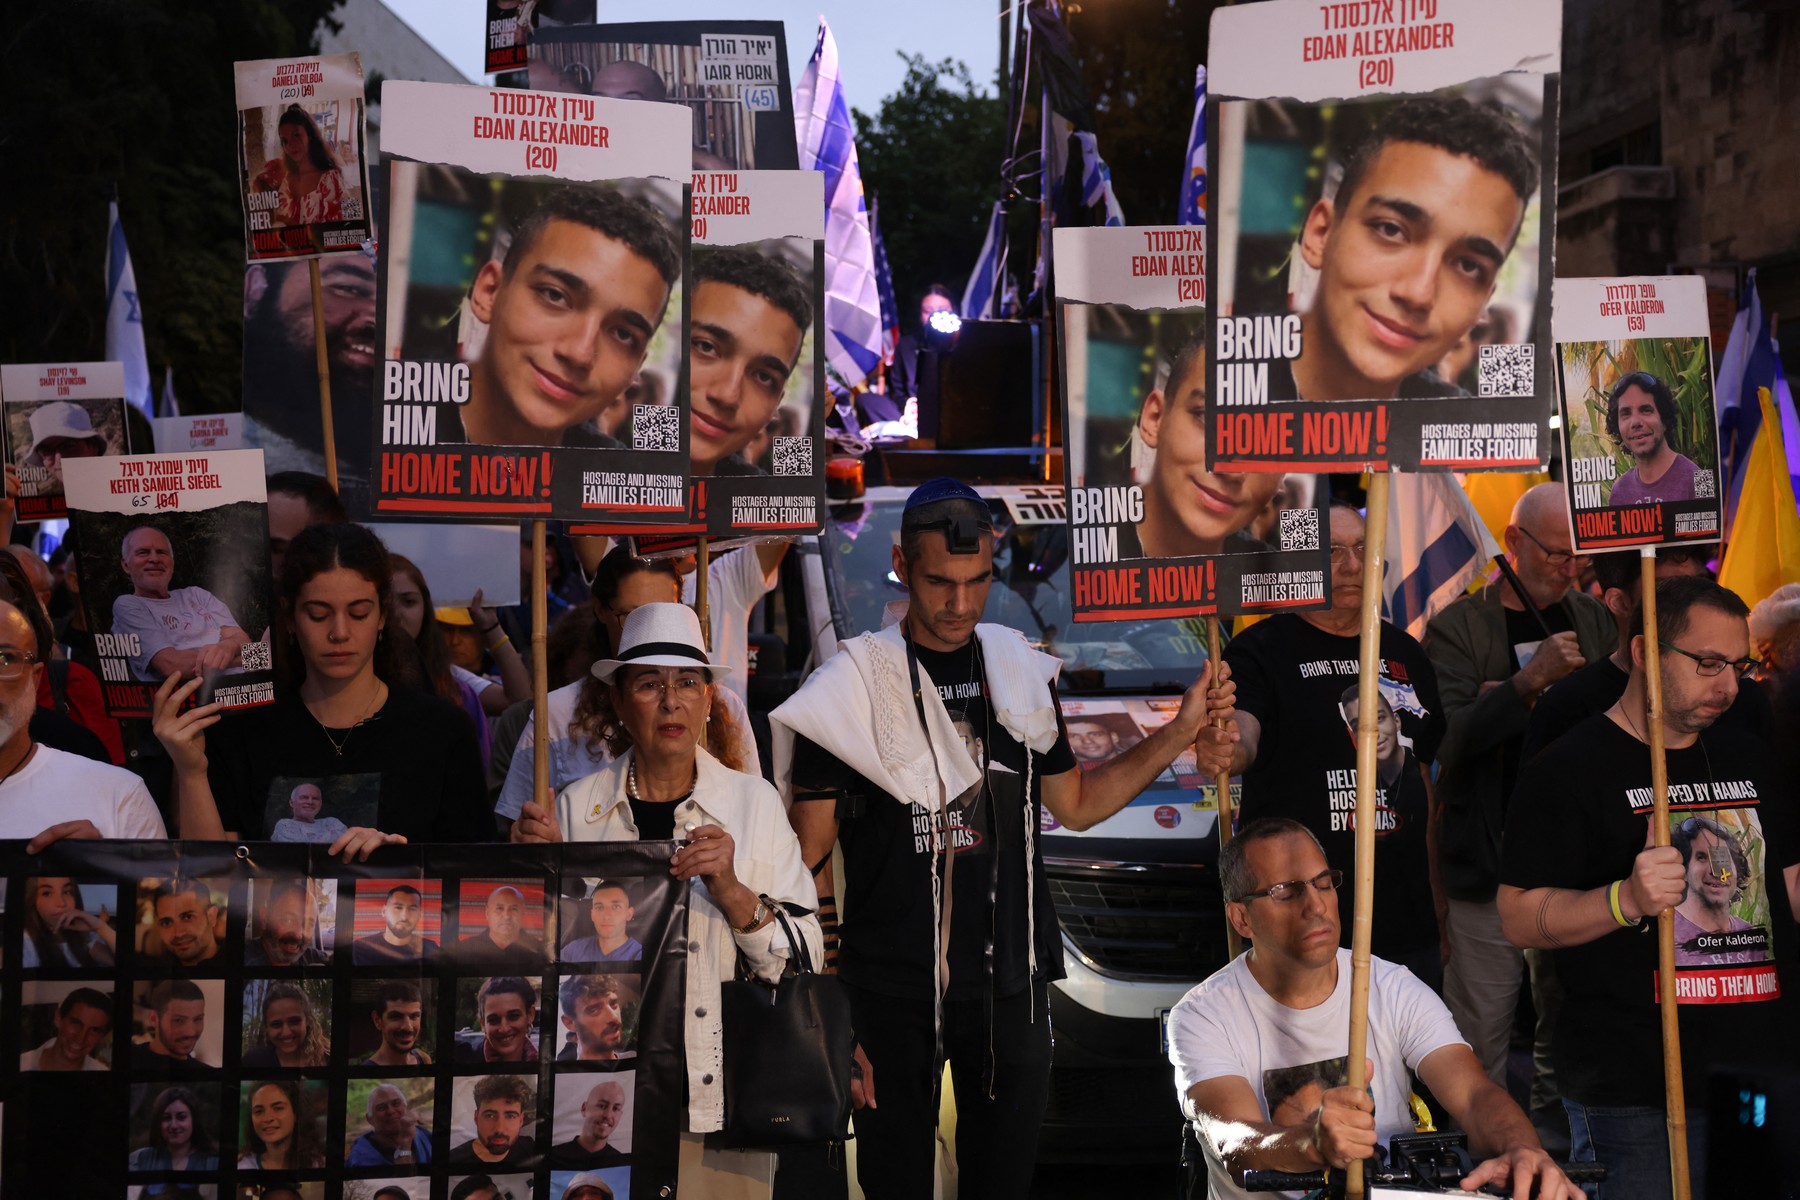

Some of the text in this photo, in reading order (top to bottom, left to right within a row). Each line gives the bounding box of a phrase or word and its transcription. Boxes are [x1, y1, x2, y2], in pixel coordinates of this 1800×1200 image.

[1320, 0, 1437, 30] עידן אלכסנדר
[490, 18, 517, 34] BRING
[490, 32, 515, 50] THEM
[705, 38, 772, 59] יאיר הורן
[1303, 22, 1454, 62] EDAN ALEXANDER
[296, 62, 320, 74] דניאלה
[704, 64, 772, 82] IAIR HORN
[1359, 57, 1394, 90] (20)
[272, 73, 323, 88] DANIELA GILBOA
[280, 88, 300, 100] (20)
[744, 86, 775, 111] (45)
[490, 92, 594, 121] עידן אלכסנדר
[473, 116, 609, 148] EDAN ALEXANDER
[526, 146, 558, 172] (20)
[710, 174, 738, 194] עידן
[247, 190, 280, 211] BRING
[692, 196, 750, 216] EXANDER
[250, 212, 272, 230] HER
[324, 236, 346, 248] FAMILIES
[1144, 229, 1202, 252] אלכסנדר
[1132, 256, 1168, 277] EDAN
[1178, 278, 1206, 302] (20)
[1606, 284, 1656, 302] עופר קלדרון
[1600, 300, 1665, 316] OFER KALDERON
[1627, 316, 1646, 332] (53)
[1216, 315, 1302, 360] BRING
[39, 376, 86, 386] SHAY LEVINSON
[384, 360, 470, 404] BRING
[1216, 362, 1269, 406] HIM
[382, 404, 437, 446] HIM
[1216, 404, 1388, 456] HOME NOW!
[1422, 422, 1538, 440] HOSTAGES AND MISSING
[1422, 438, 1538, 460] FAMILIES FORUM
[16, 466, 48, 482] BRING
[120, 458, 208, 478] קית' שמואל סיגל
[381, 451, 552, 498] HOME NOW!
[1572, 456, 1616, 482] BRING
[110, 474, 222, 495] KEITH SAMUEL SIEGEL
[583, 472, 682, 488] HOSTAGES AND MISSING
[132, 495, 151, 508] 65
[583, 485, 637, 506] FAMILIES
[640, 487, 683, 507] FORUM
[732, 496, 816, 507] HOSTAGES AND MISSING
[1072, 485, 1144, 525] BRING
[1574, 484, 1602, 510] HIM
[732, 508, 816, 524] FAMILIES FORUM
[1576, 504, 1664, 538] HOME NOW!
[1675, 519, 1718, 534] FAMILIES FORUM
[1073, 526, 1119, 564] HIM
[1074, 560, 1217, 608] HOME NOW!
[1242, 570, 1324, 586] HOSTAGES AND MISSING
[1242, 582, 1324, 603] FAMILIES FORUM
[94, 632, 141, 658] BRING
[100, 659, 130, 682] HIM
[1300, 660, 1332, 678] BRING
[1332, 658, 1360, 675] THEM
[106, 684, 149, 710] HOME
[214, 682, 274, 697] HOSTAGES AND MISSING
[216, 693, 248, 708] FAMILIES
[249, 689, 274, 704] FORUM
[936, 685, 954, 700] EM
[1329, 789, 1388, 810] HOSGE
[1694, 782, 1710, 802] BY
[1710, 780, 1758, 799] HAMAS
[1330, 811, 1396, 831] BY MAS
[914, 835, 930, 854] BY
[1698, 934, 1766, 948] Ofer Kalderon
[1675, 972, 1777, 998] BRING THEM HOME
